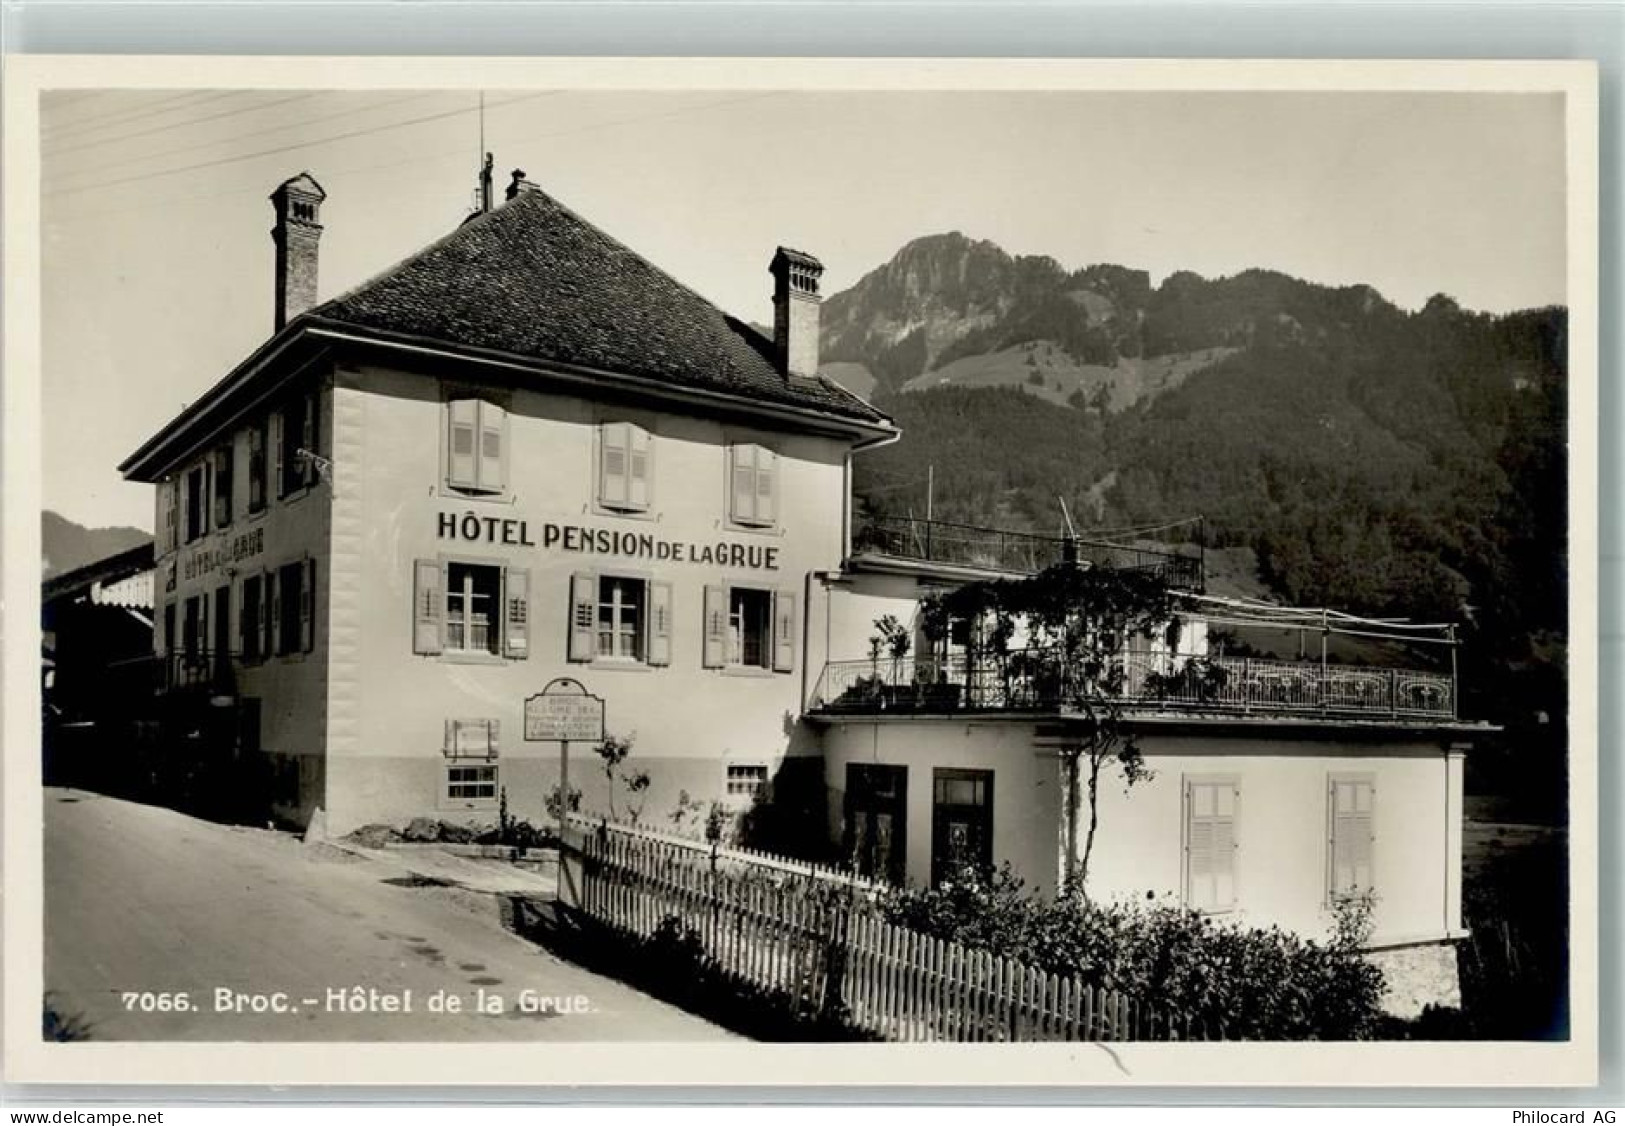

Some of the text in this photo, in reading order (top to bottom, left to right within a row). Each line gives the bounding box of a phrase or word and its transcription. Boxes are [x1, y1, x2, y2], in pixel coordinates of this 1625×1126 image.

[438, 510, 535, 547] HÔTEL
[544, 523, 653, 559] PENSION
[656, 541, 684, 562] DE
